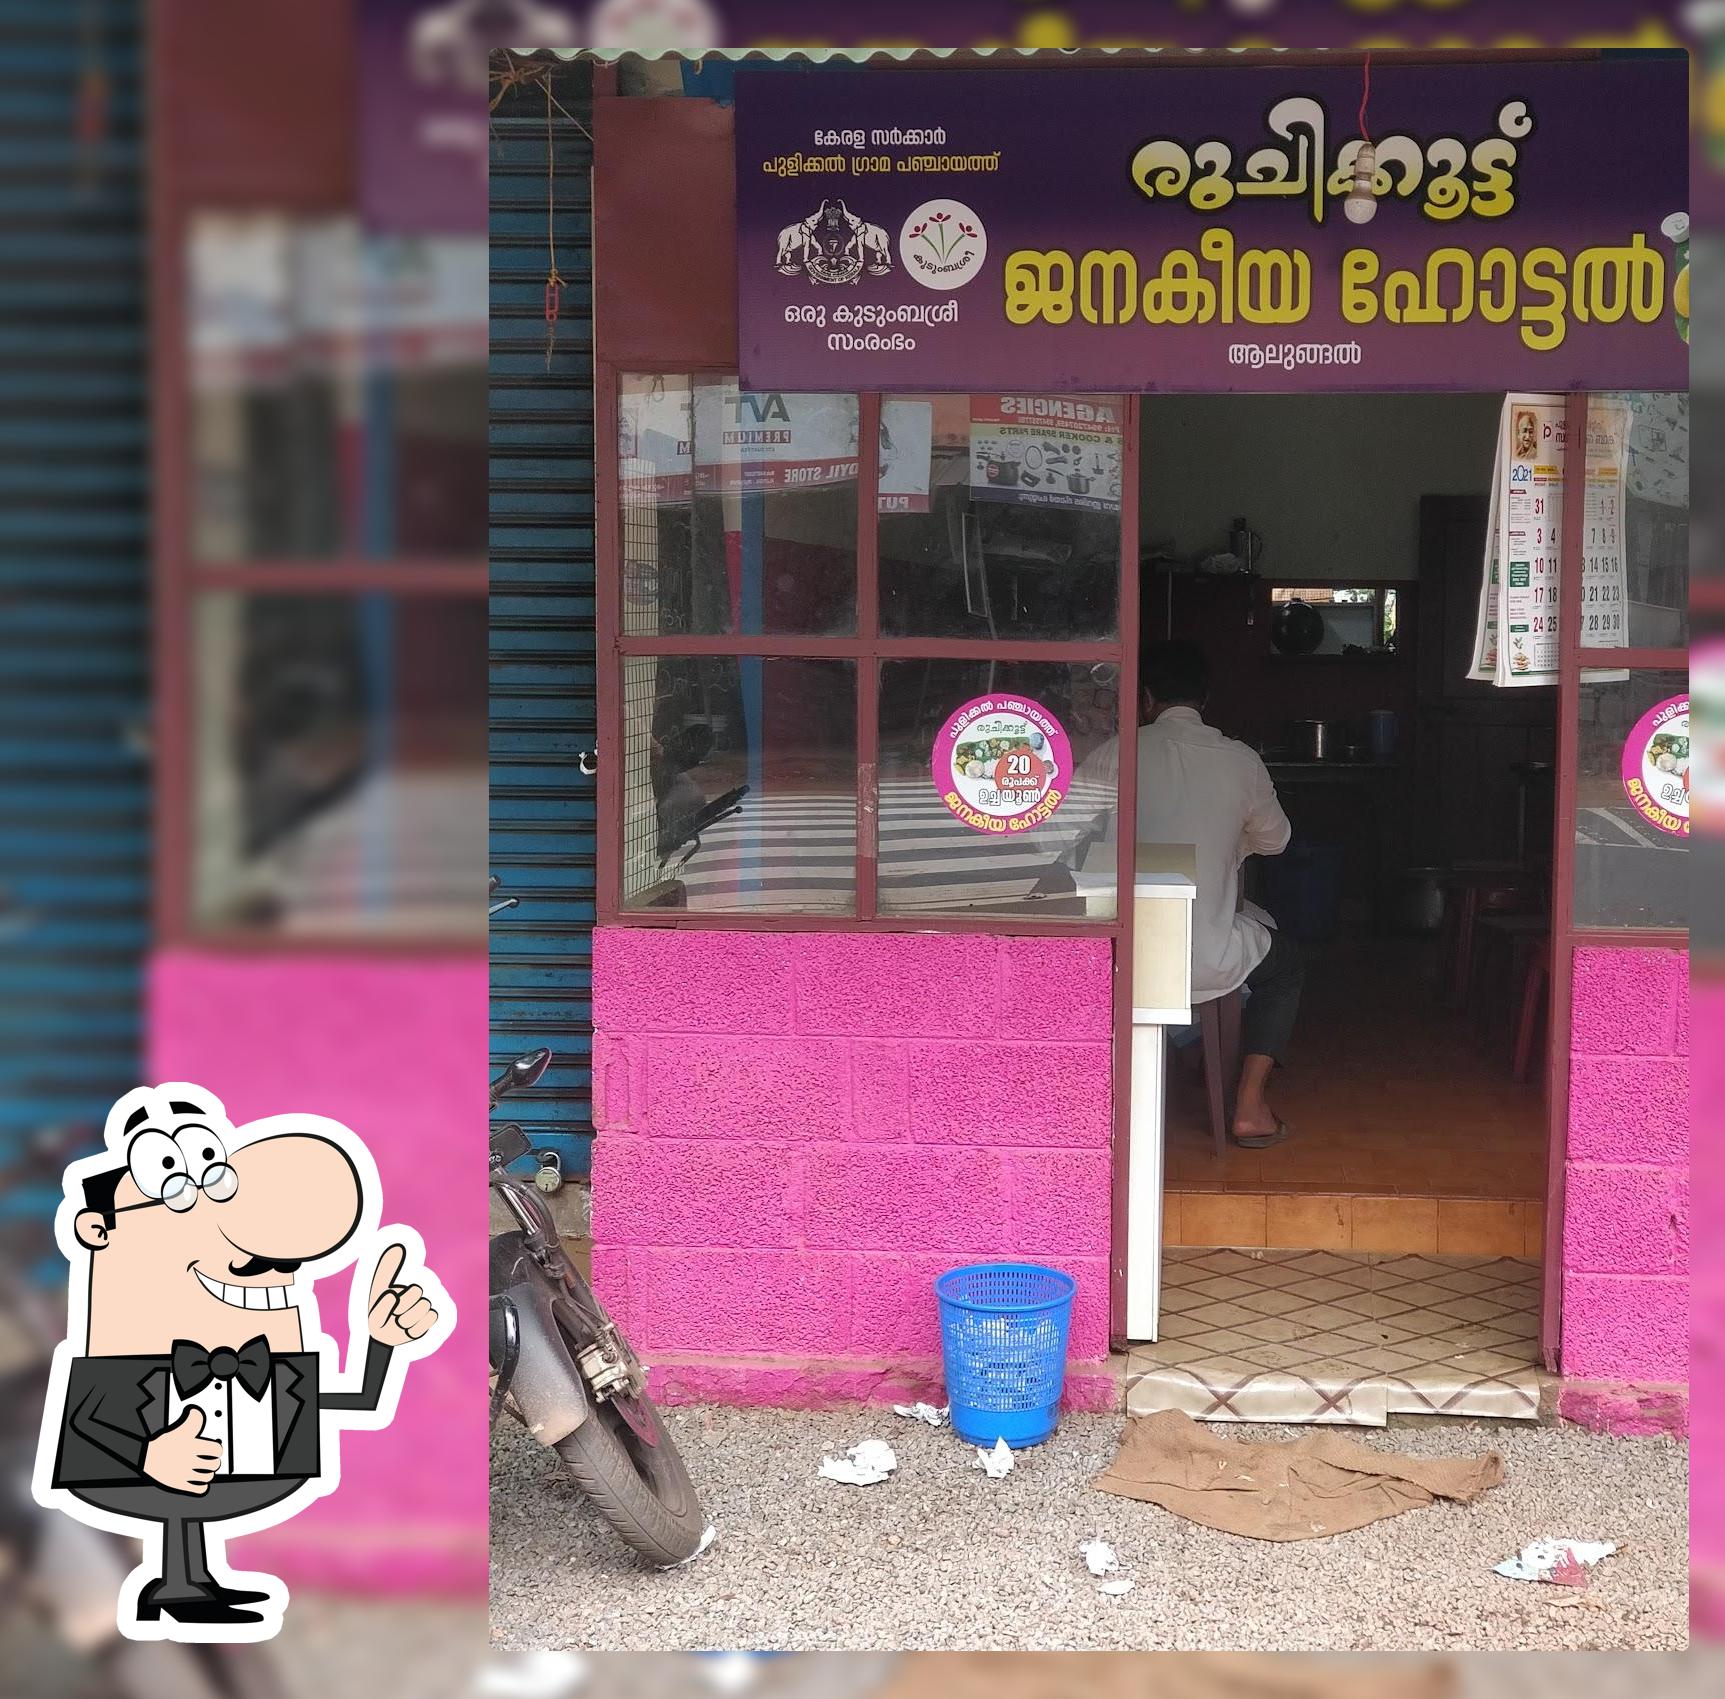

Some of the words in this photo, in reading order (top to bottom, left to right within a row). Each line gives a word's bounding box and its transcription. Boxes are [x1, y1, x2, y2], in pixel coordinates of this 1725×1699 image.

[814, 129, 865, 149] കേരള
[871, 127, 947, 146] സർക്കാർ
[762, 152, 847, 176] പുളിക്കൽ
[851, 155, 891, 176] ഗ്രാമ
[897, 151, 1001, 172] പഞ്ചായത്ത്
[1131, 96, 1534, 225] രുചിക്കൂട്ട്
[1004, 227, 1311, 326] ജനകീയ
[1342, 233, 1665, 351] ഹോട്ടൽ
[784, 305, 826, 328] ഒരു
[832, 300, 959, 327] കുടുംബശ്രീ
[828, 333, 916, 351] സംരംഭം
[1228, 339, 1363, 371] ആലുങ്ങൽ
[1512, 465, 1532, 482] 2021
[1535, 498, 1544, 514] 31
[1537, 528, 1542, 544] 3
[1551, 528, 1556, 544] 4
[1592, 528, 1596, 544] 7
[1602, 528, 1606, 544] 8
[1535, 557, 1544, 573] 10
[1549, 557, 1557, 573] 11
[1590, 557, 1598, 572] 14
[1602, 557, 1608, 572] 15
[1611, 557, 1618, 572] 16
[1535, 587, 1544, 603] 17
[1548, 587, 1557, 602] 18
[1590, 586, 1598, 601] 21
[1602, 586, 1610, 601] 22
[1613, 586, 1619, 601] 23
[1534, 617, 1543, 632] 24
[1548, 616, 1557, 632] 25
[1589, 615, 1598, 630] 28
[1602, 614, 1610, 630] 29
[1613, 614, 1620, 630] 30
[950, 701, 994, 739] പുളിക്കൽ
[997, 700, 1059, 737] പഞ്ചായത്ത്
[1007, 755, 1031, 775] 20
[979, 788, 1042, 806] ഉച്ചയൂൺ
[1627, 777, 1682, 831] ജനകീയ
[945, 791, 1007, 832] ജനകീയ
[1009, 789, 1062, 830] ഹോട്ടൽ
